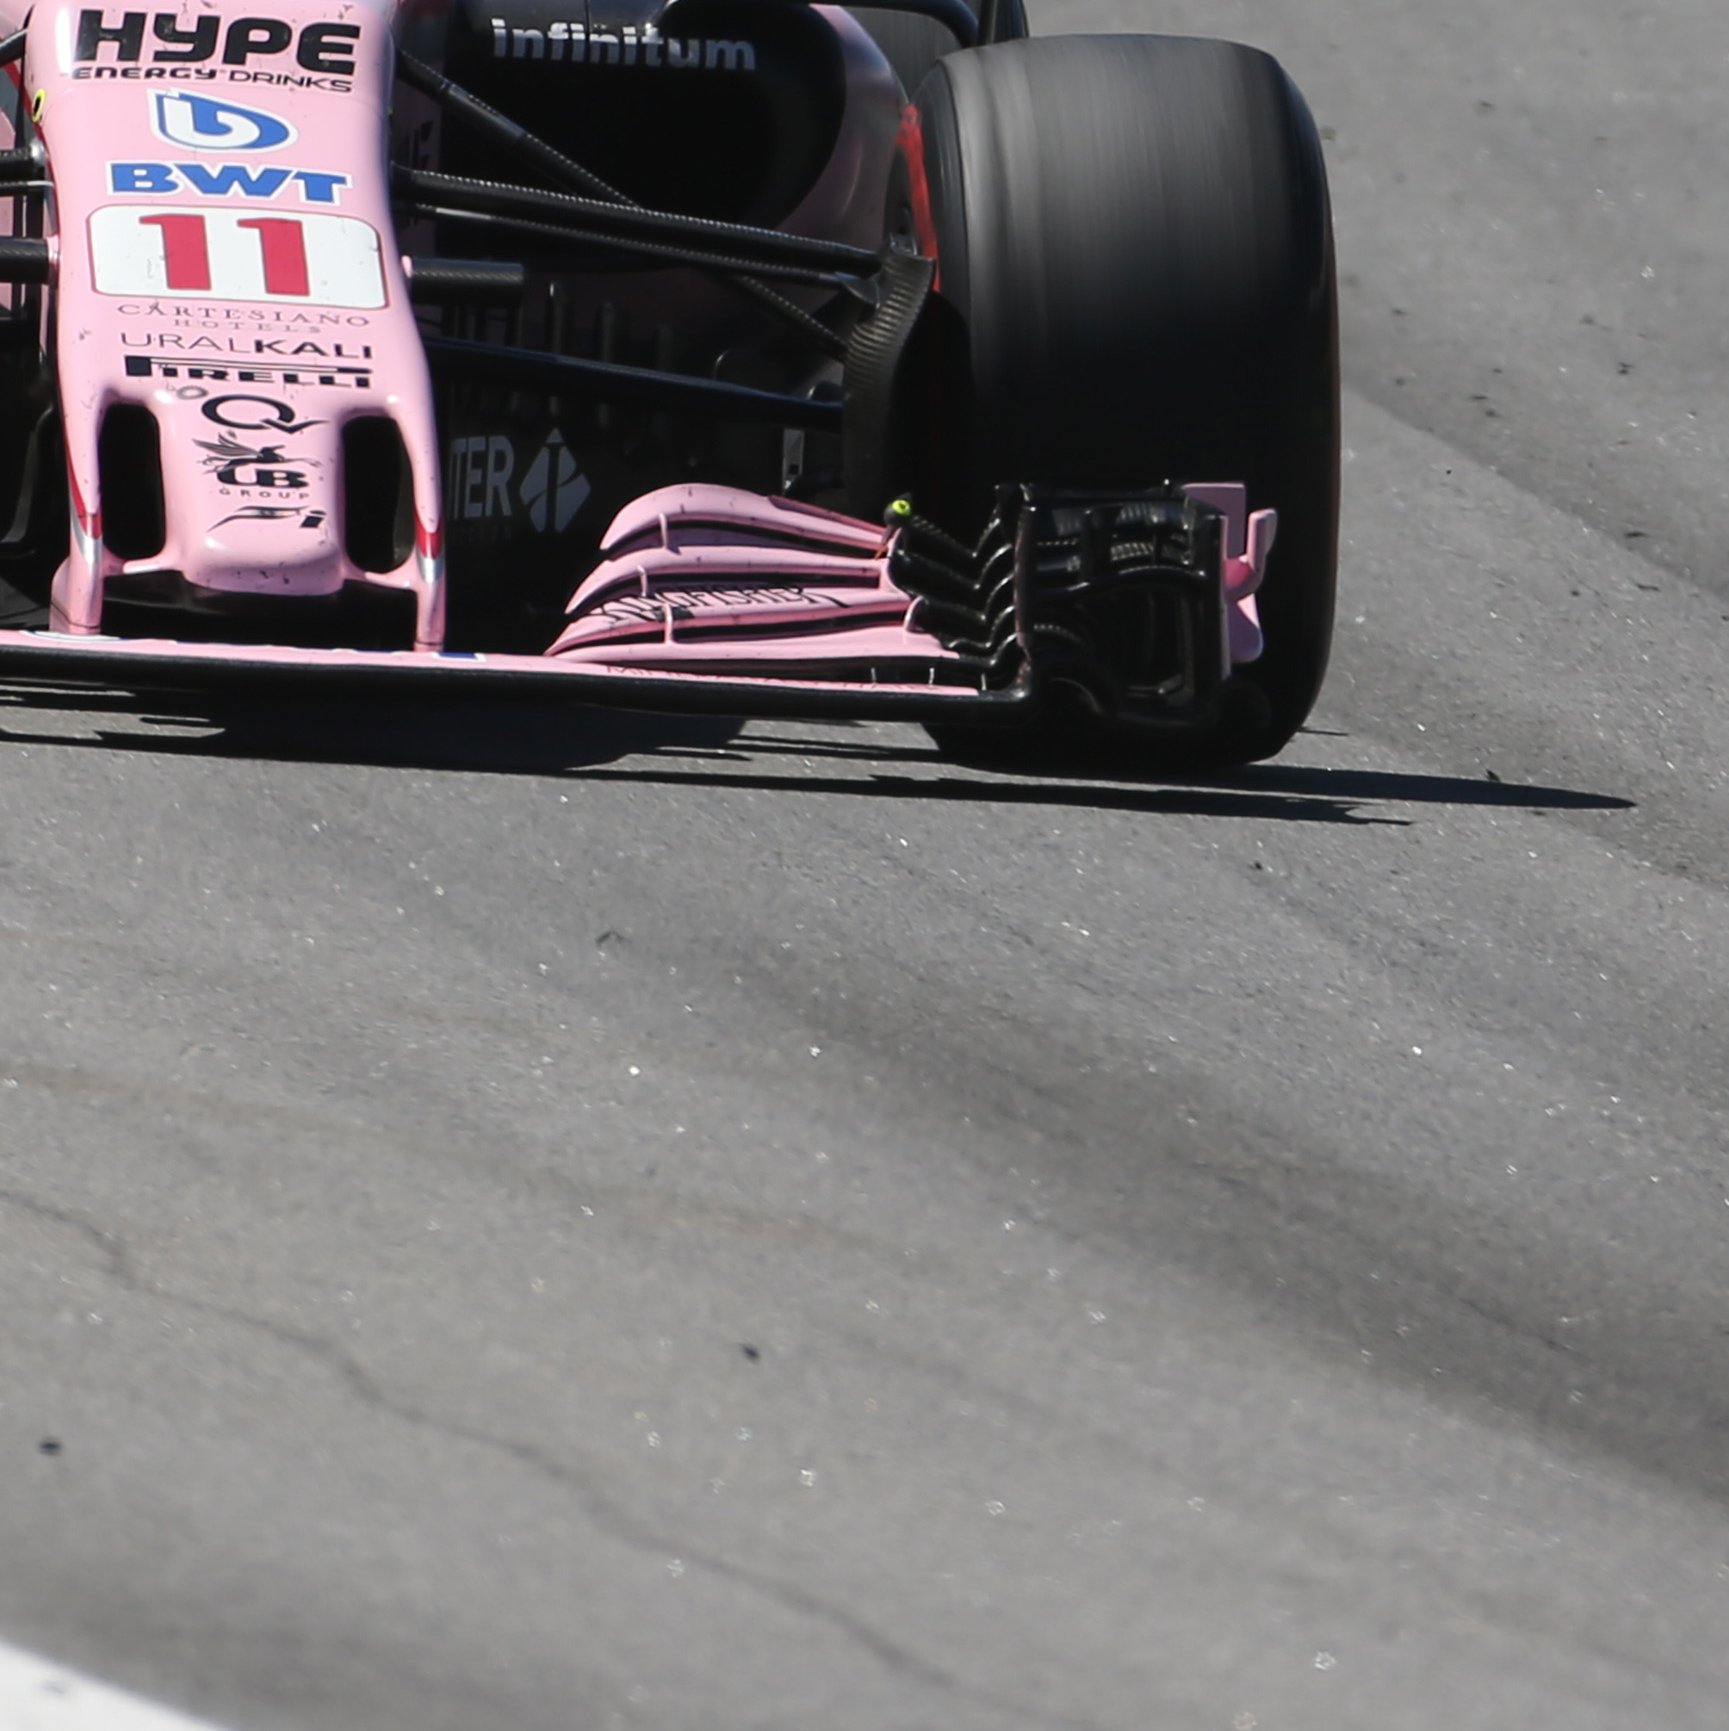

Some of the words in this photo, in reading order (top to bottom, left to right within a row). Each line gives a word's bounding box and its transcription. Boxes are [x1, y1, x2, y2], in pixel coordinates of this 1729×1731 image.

[74, 9, 360, 76] HYPE
[491, 18, 757, 71] infinitum
[72, 66, 216, 80] ENERGY
[228, 71, 354, 93] DRINKS
[110, 162, 347, 203] BWT
[139, 213, 310, 297] 11
[117, 303, 370, 327] CARTESIANO
[173, 318, 321, 333] HOTELS
[120, 332, 373, 360] URALKALI
[124, 355, 374, 388] PIRELLI
[218, 488, 310, 500] GROUP
